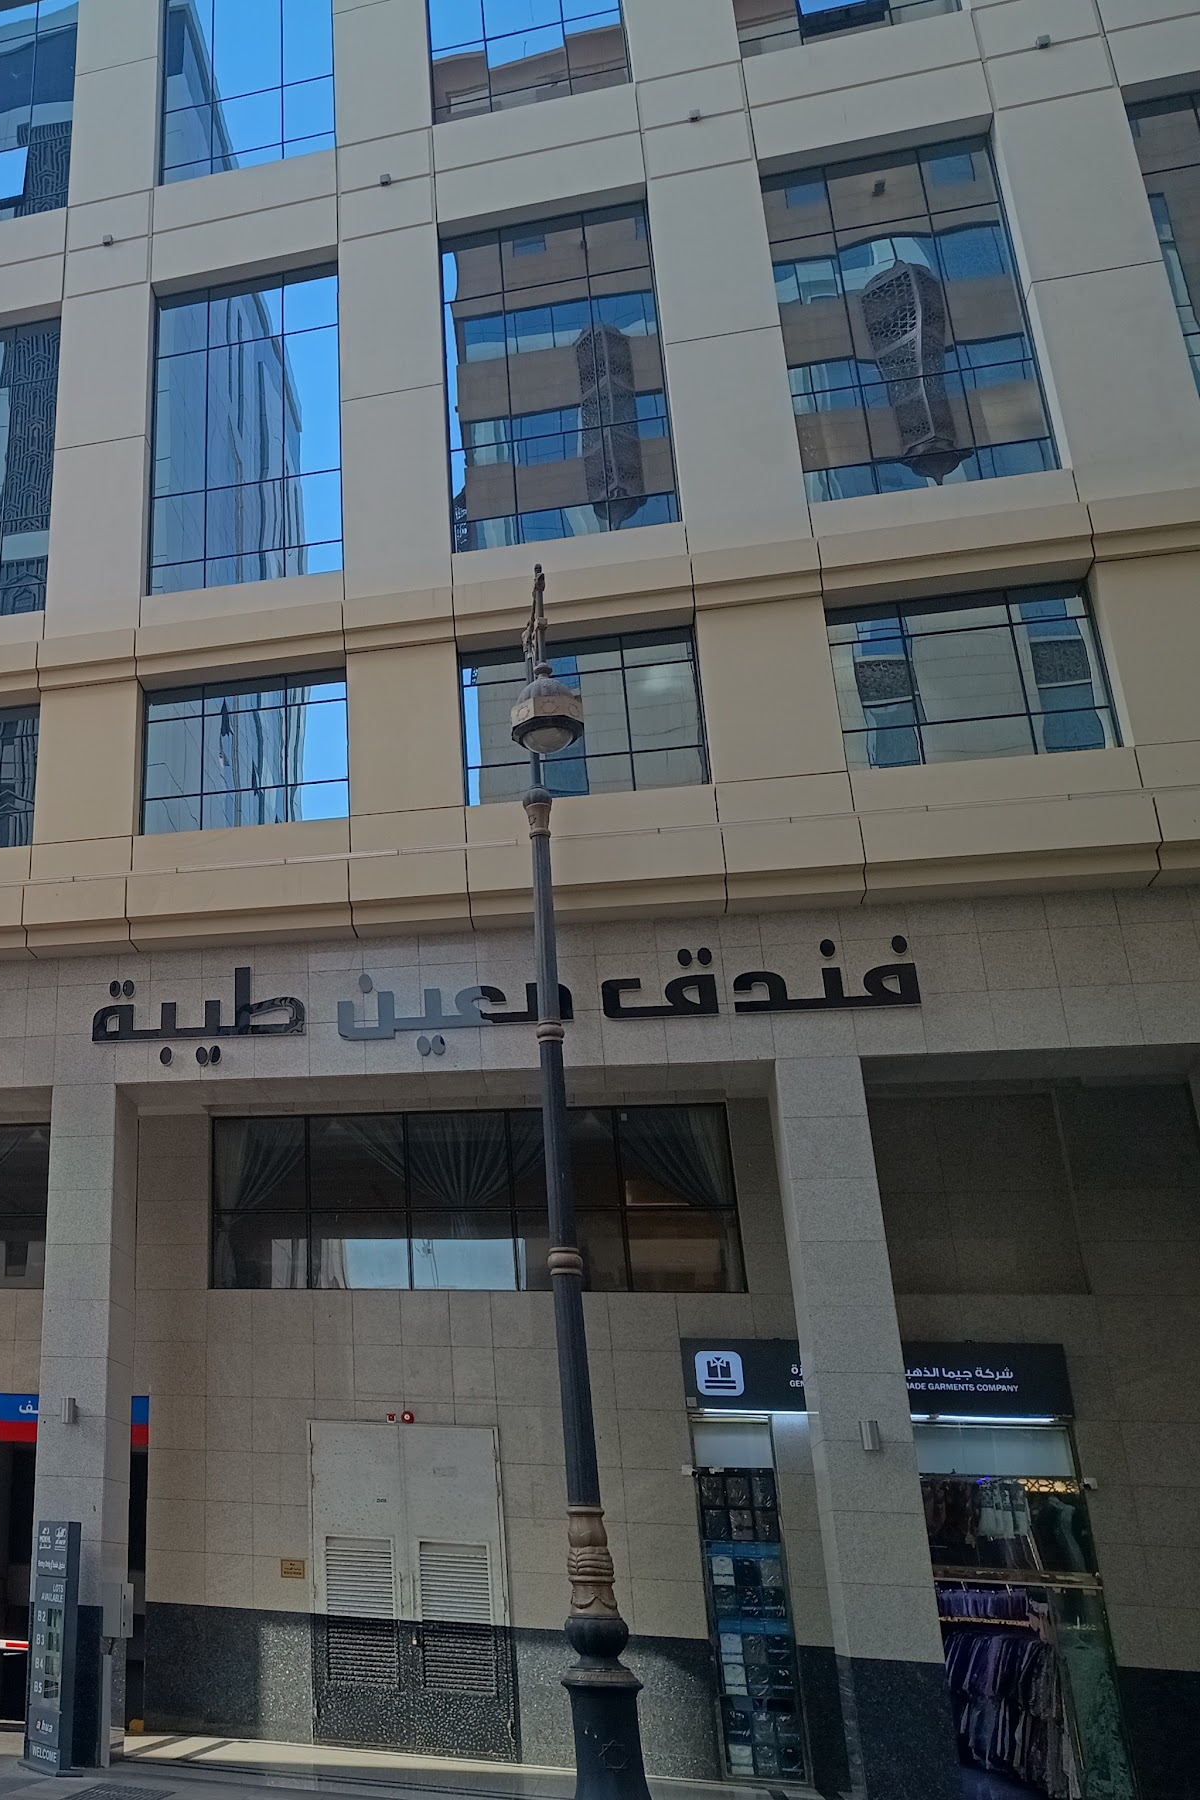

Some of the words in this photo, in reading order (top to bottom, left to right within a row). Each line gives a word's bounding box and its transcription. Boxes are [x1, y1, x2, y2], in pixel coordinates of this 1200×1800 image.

[601, 935, 922, 1020] فندق
[92, 966, 307, 1066] طيبة
[905, 1367, 939, 1379] الذهب
[942, 1367, 972, 1380] جيما
[975, 1367, 1013, 1380] شركة
[928, 1383, 975, 1392] GARMENTS
[977, 1384, 1019, 1392] COMPANY
[53, 1584, 64, 1593] LOTS
[41, 1592, 64, 1603] AVAILABLE
[37, 1610, 46, 1622] B2
[36, 1633, 45, 1646] B3
[35, 1657, 43, 1669] B4
[33, 1680, 42, 1693] B5
[32, 1745, 58, 1763] WELCOME
